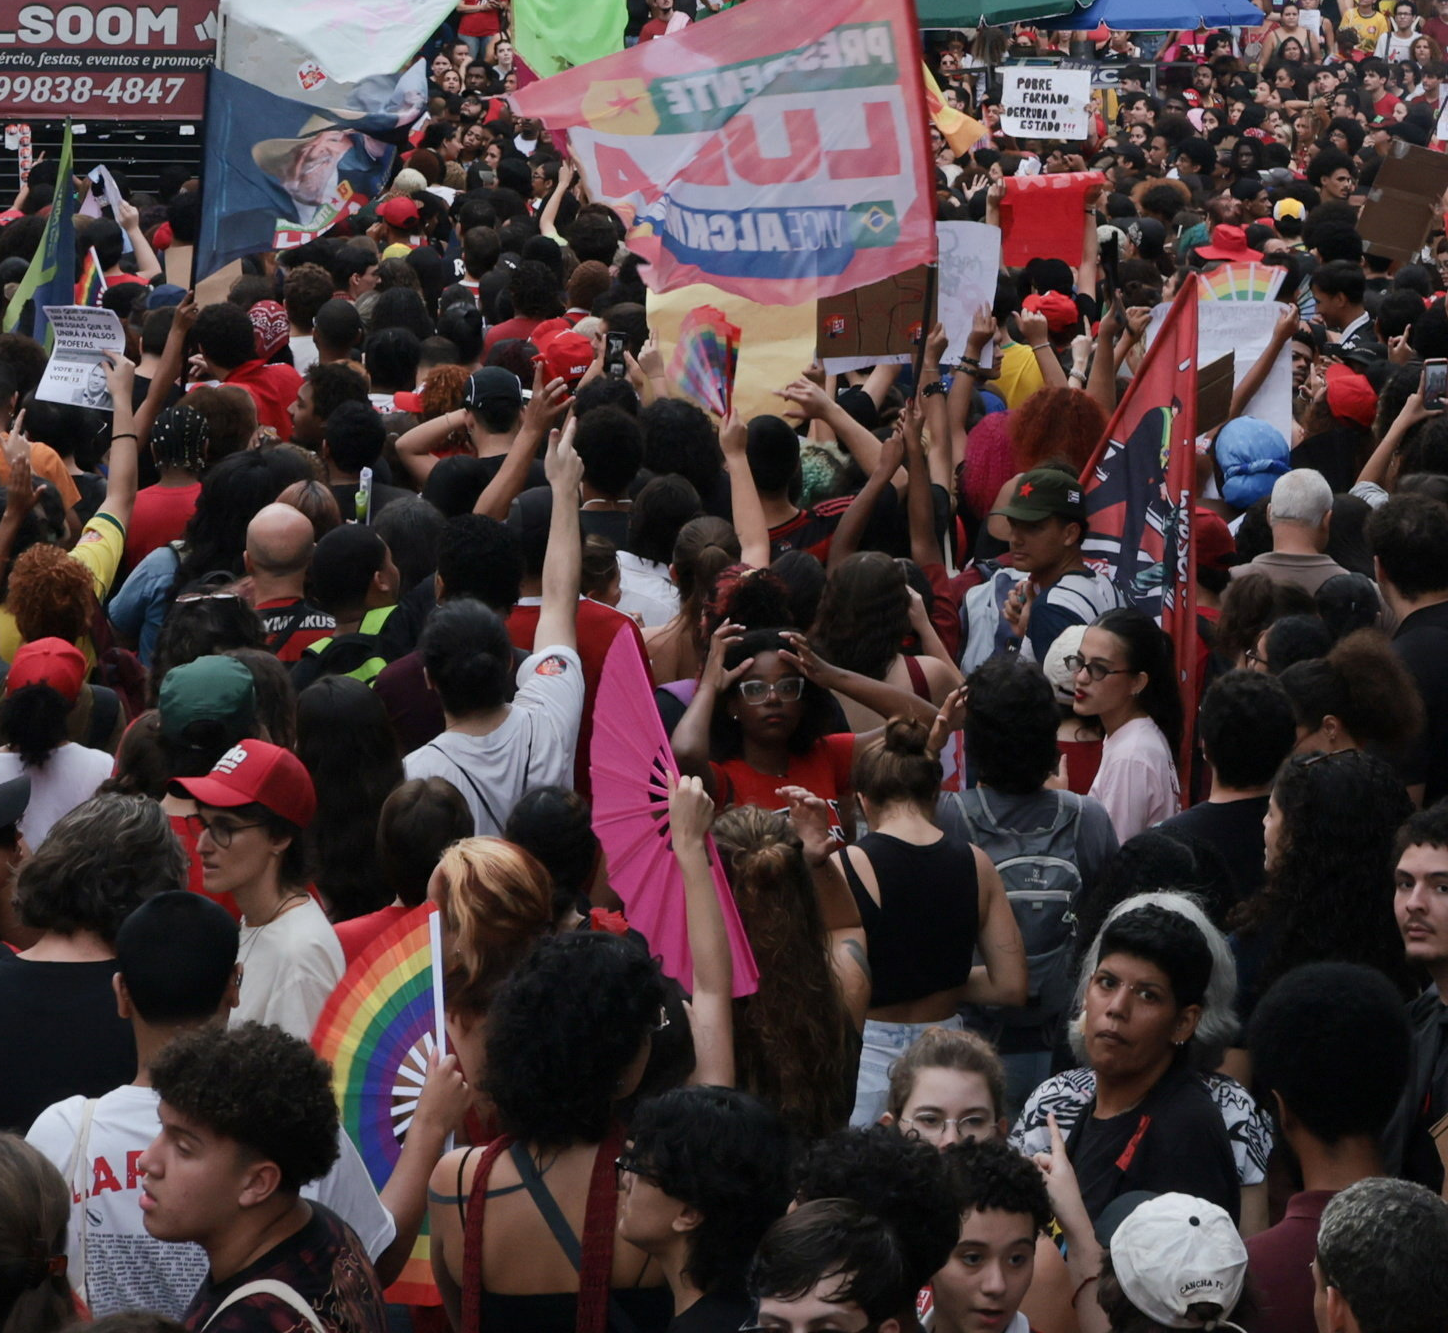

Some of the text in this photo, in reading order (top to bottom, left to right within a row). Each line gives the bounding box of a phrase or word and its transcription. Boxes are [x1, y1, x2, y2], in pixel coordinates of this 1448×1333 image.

[36, 51, 84, 69] festas,
[86, 54, 139, 67] eventos
[141, 56, 150, 67] e
[1017, 77, 1052, 91] POBRE
[1022, 92, 1069, 105] FORMADO
[1007, 107, 1057, 120] DERRUBA O
[1020, 120, 1060, 132] ESTADO
[66, 315, 89, 324] FALSO
[53, 321, 113, 332] MESSIAS QUE SE
[88, 331, 117, 341] FALSOS
[57, 339, 96, 350] PROFETAS.
[53, 365, 72, 373] VOTE
[49, 374, 68, 383] VOTE
